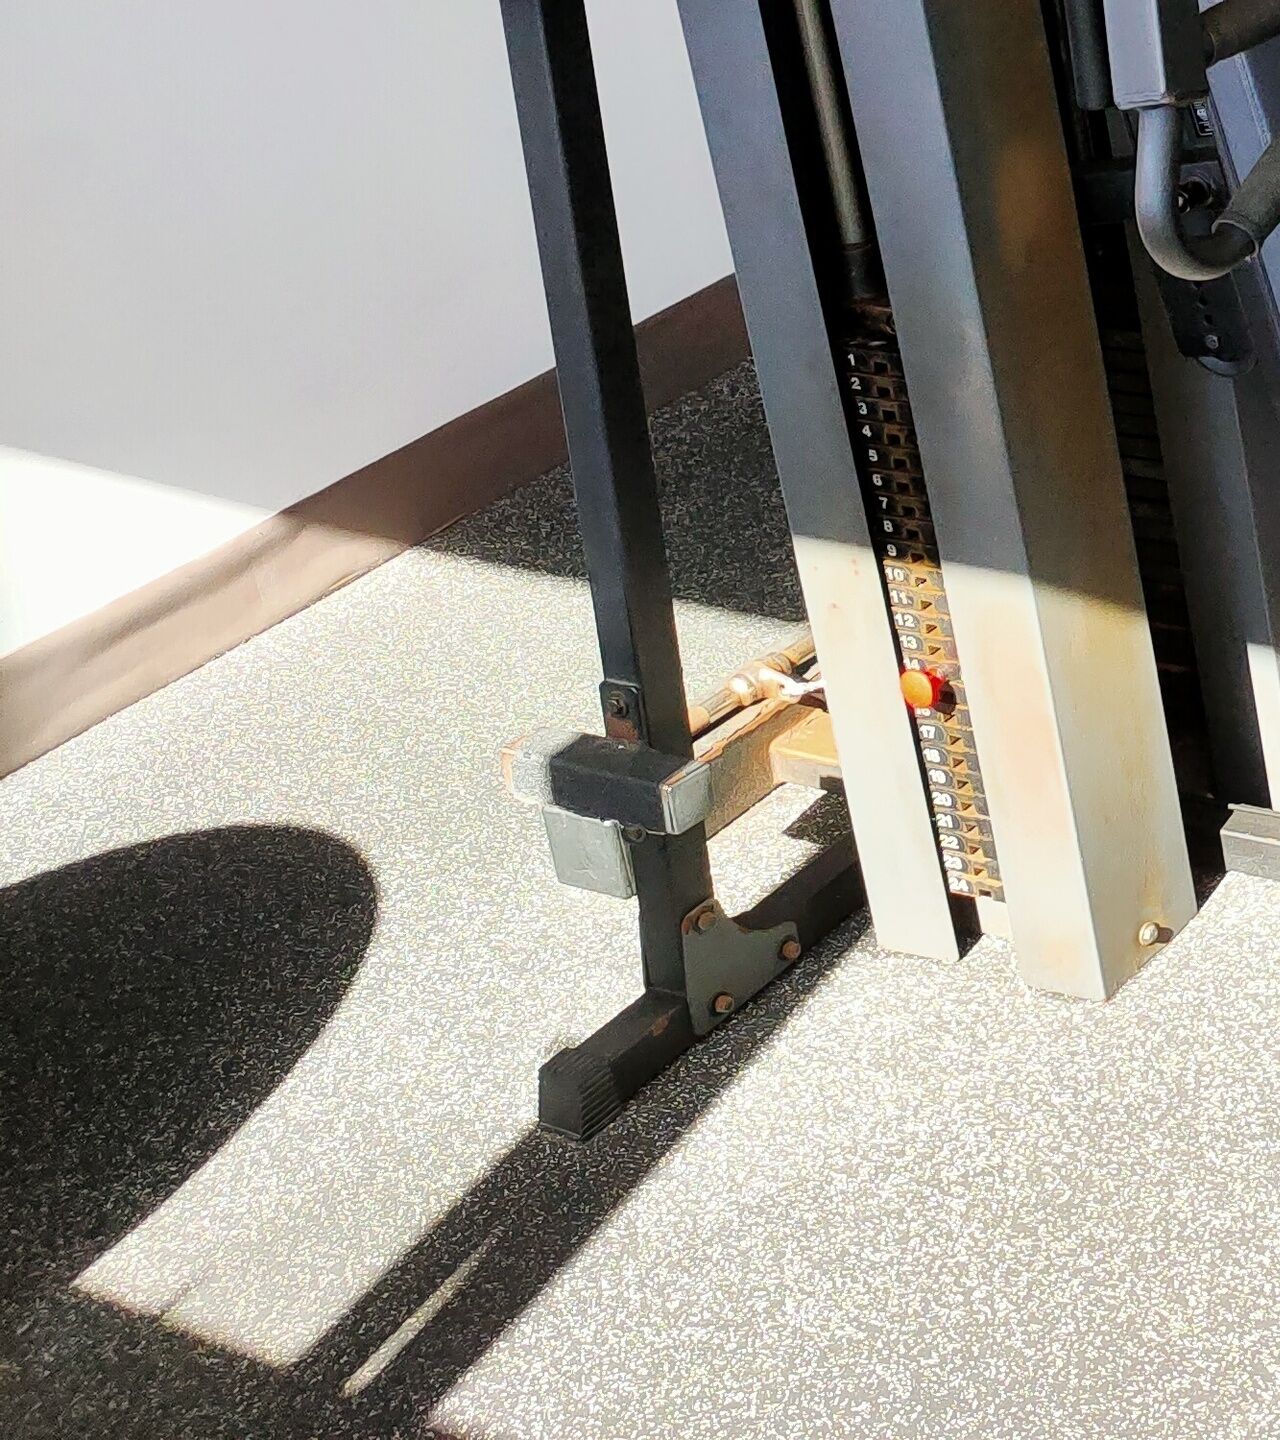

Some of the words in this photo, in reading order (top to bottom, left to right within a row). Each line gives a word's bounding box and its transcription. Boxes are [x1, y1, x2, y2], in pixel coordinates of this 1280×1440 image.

[848, 353, 856, 366] 1
[851, 377, 862, 390] 2
[857, 402, 868, 415] 3
[862, 424, 872, 438] 4
[868, 449, 878, 462] 5
[872, 473, 883, 486] 6
[878, 496, 888, 509] 7
[883, 520, 894, 533] 8
[886, 544, 897, 557] 9
[884, 567, 907, 583] 10
[889, 590, 908, 604] 11
[894, 613, 916, 628] 12
[899, 635, 918, 650] 13
[918, 724, 936, 740] 17
[931, 791, 952, 807] 20
[936, 813, 954, 829] 21
[939, 834, 960, 850] 22
